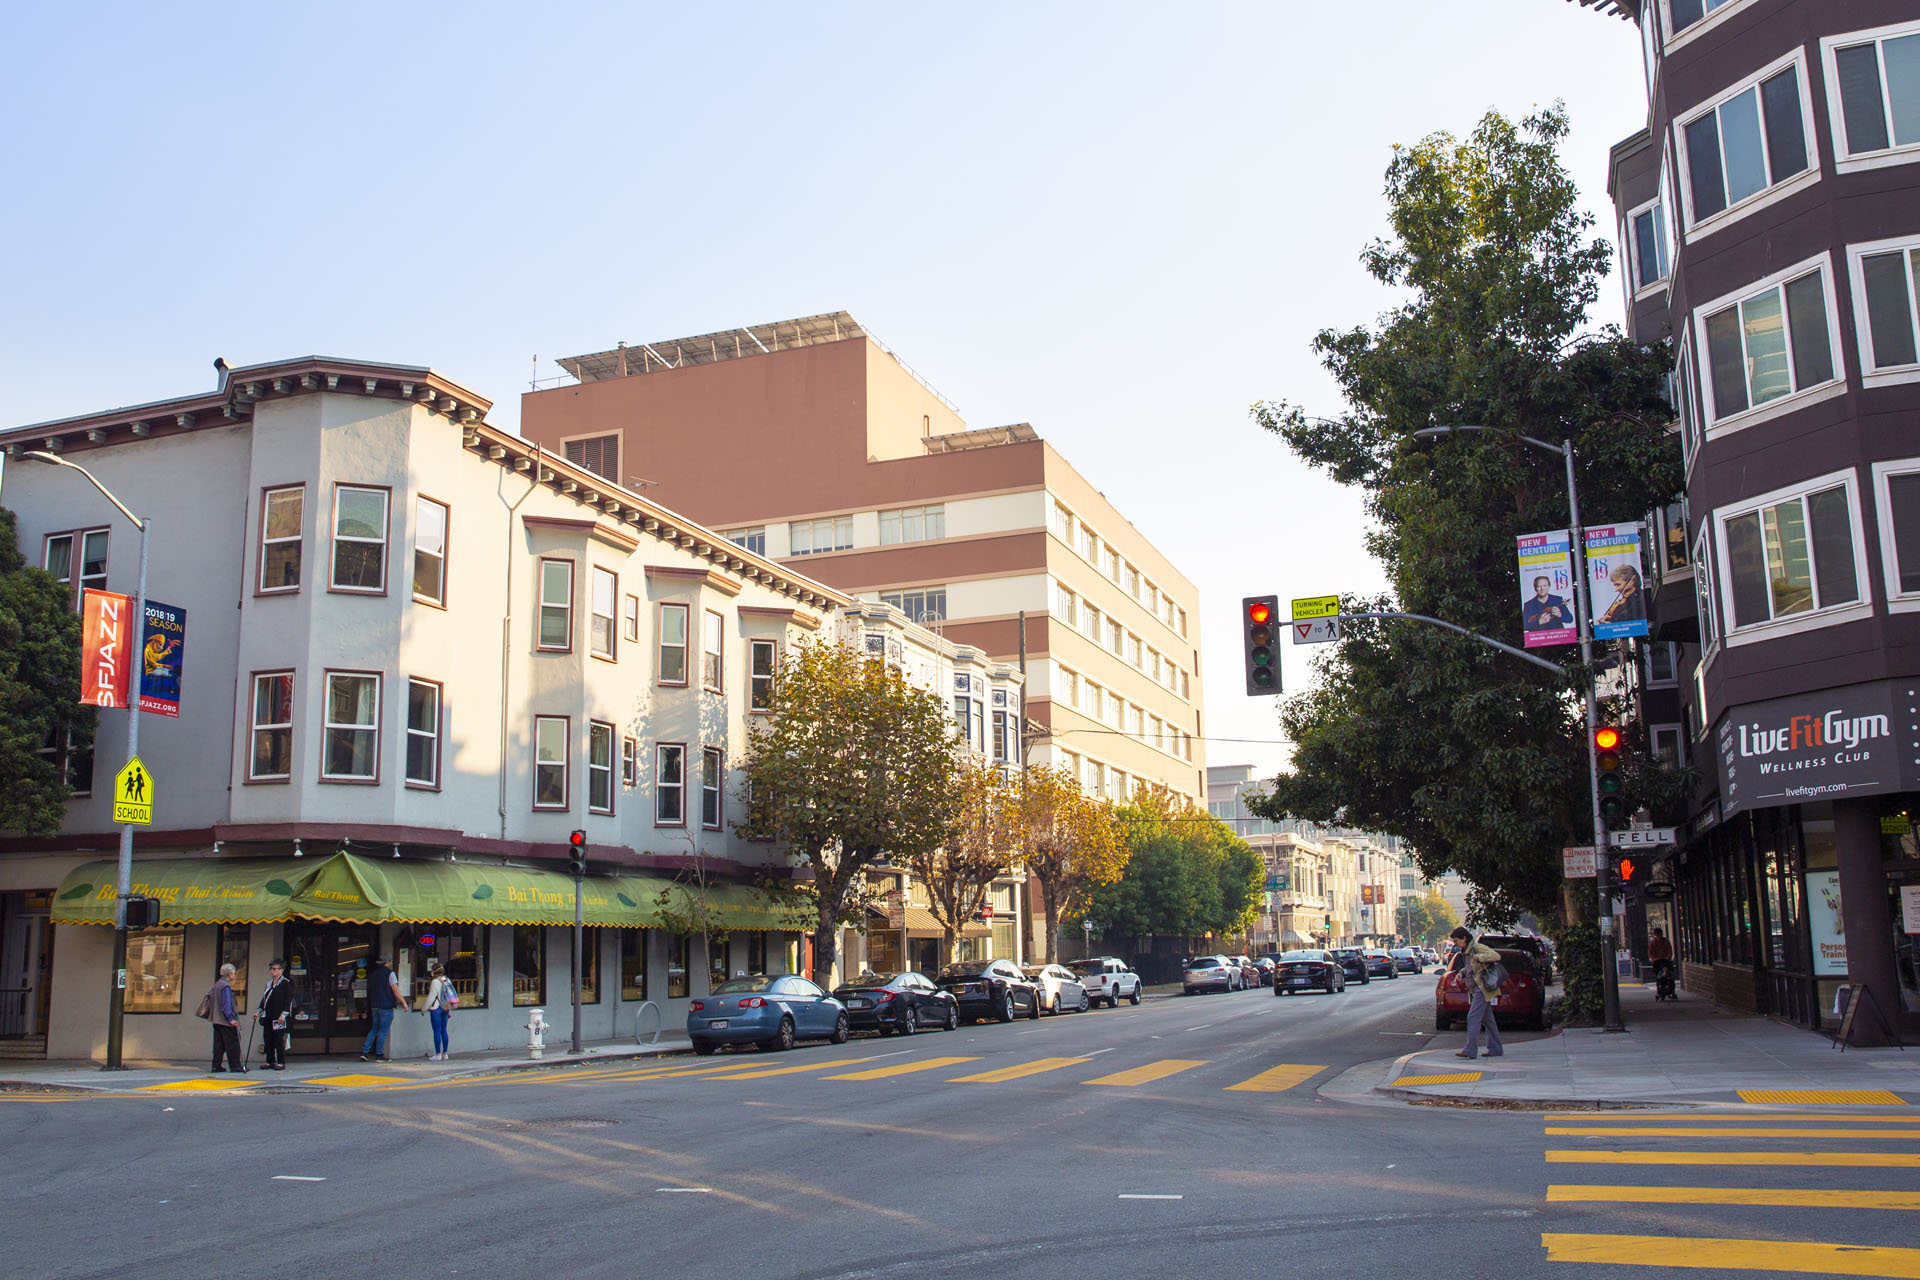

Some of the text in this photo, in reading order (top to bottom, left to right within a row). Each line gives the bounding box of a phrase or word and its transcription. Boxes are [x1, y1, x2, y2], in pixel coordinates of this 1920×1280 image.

[1589, 530, 1609, 539] NEW
[1590, 535, 1629, 547] CENTURY
[1521, 538, 1541, 548] NEW
[1522, 544, 1561, 556] CENTURY
[1295, 608, 1324, 617] VEHICLES
[148, 616, 183, 632] SEASON
[97, 599, 118, 707] SFJAZZ
[1785, 782, 1847, 797] livefitgym.com
[117, 806, 148, 820] SCHOOL
[1617, 832, 1668, 843] FELL
[1564, 848, 1573, 857] NO
[96, 883, 257, 903] Ba Thong Thai Cuisine
[314, 889, 360, 903] Bai Thong
[508, 886, 528, 902] Bai
[529, 887, 563, 907] Thong
